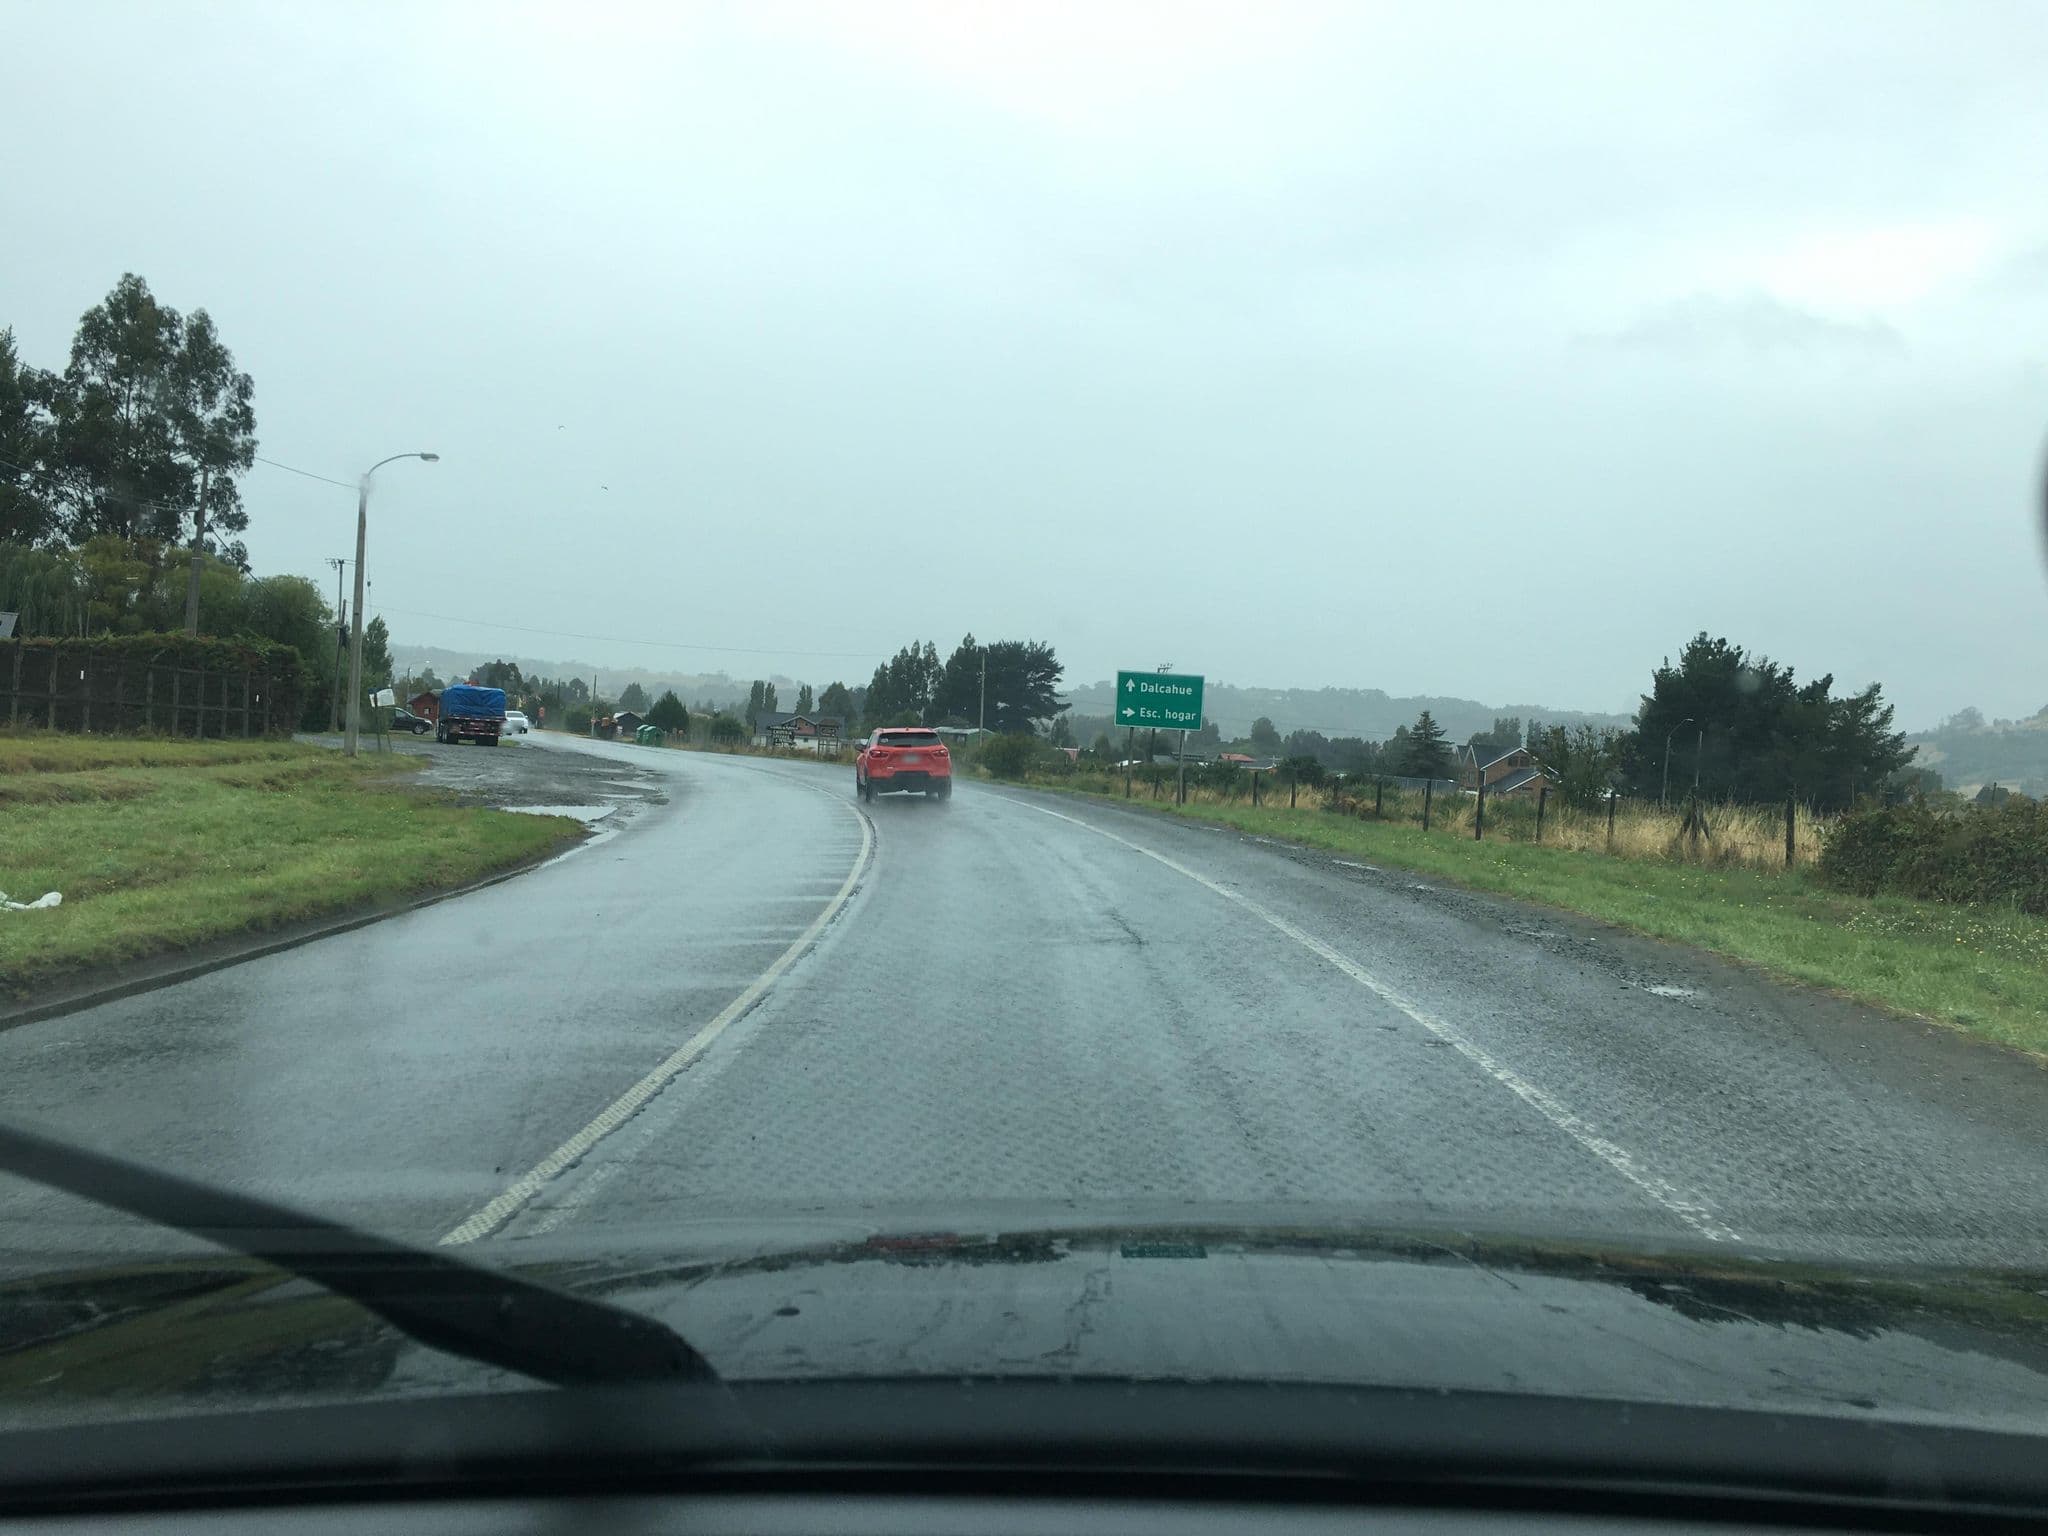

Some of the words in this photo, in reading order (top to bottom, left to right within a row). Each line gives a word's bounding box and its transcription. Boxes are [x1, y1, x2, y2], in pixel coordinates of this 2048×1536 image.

[1140, 682, 1193, 695] Dalcahue
[1140, 707, 1161, 718] Esc.
[1165, 709, 1196, 722] hogar
